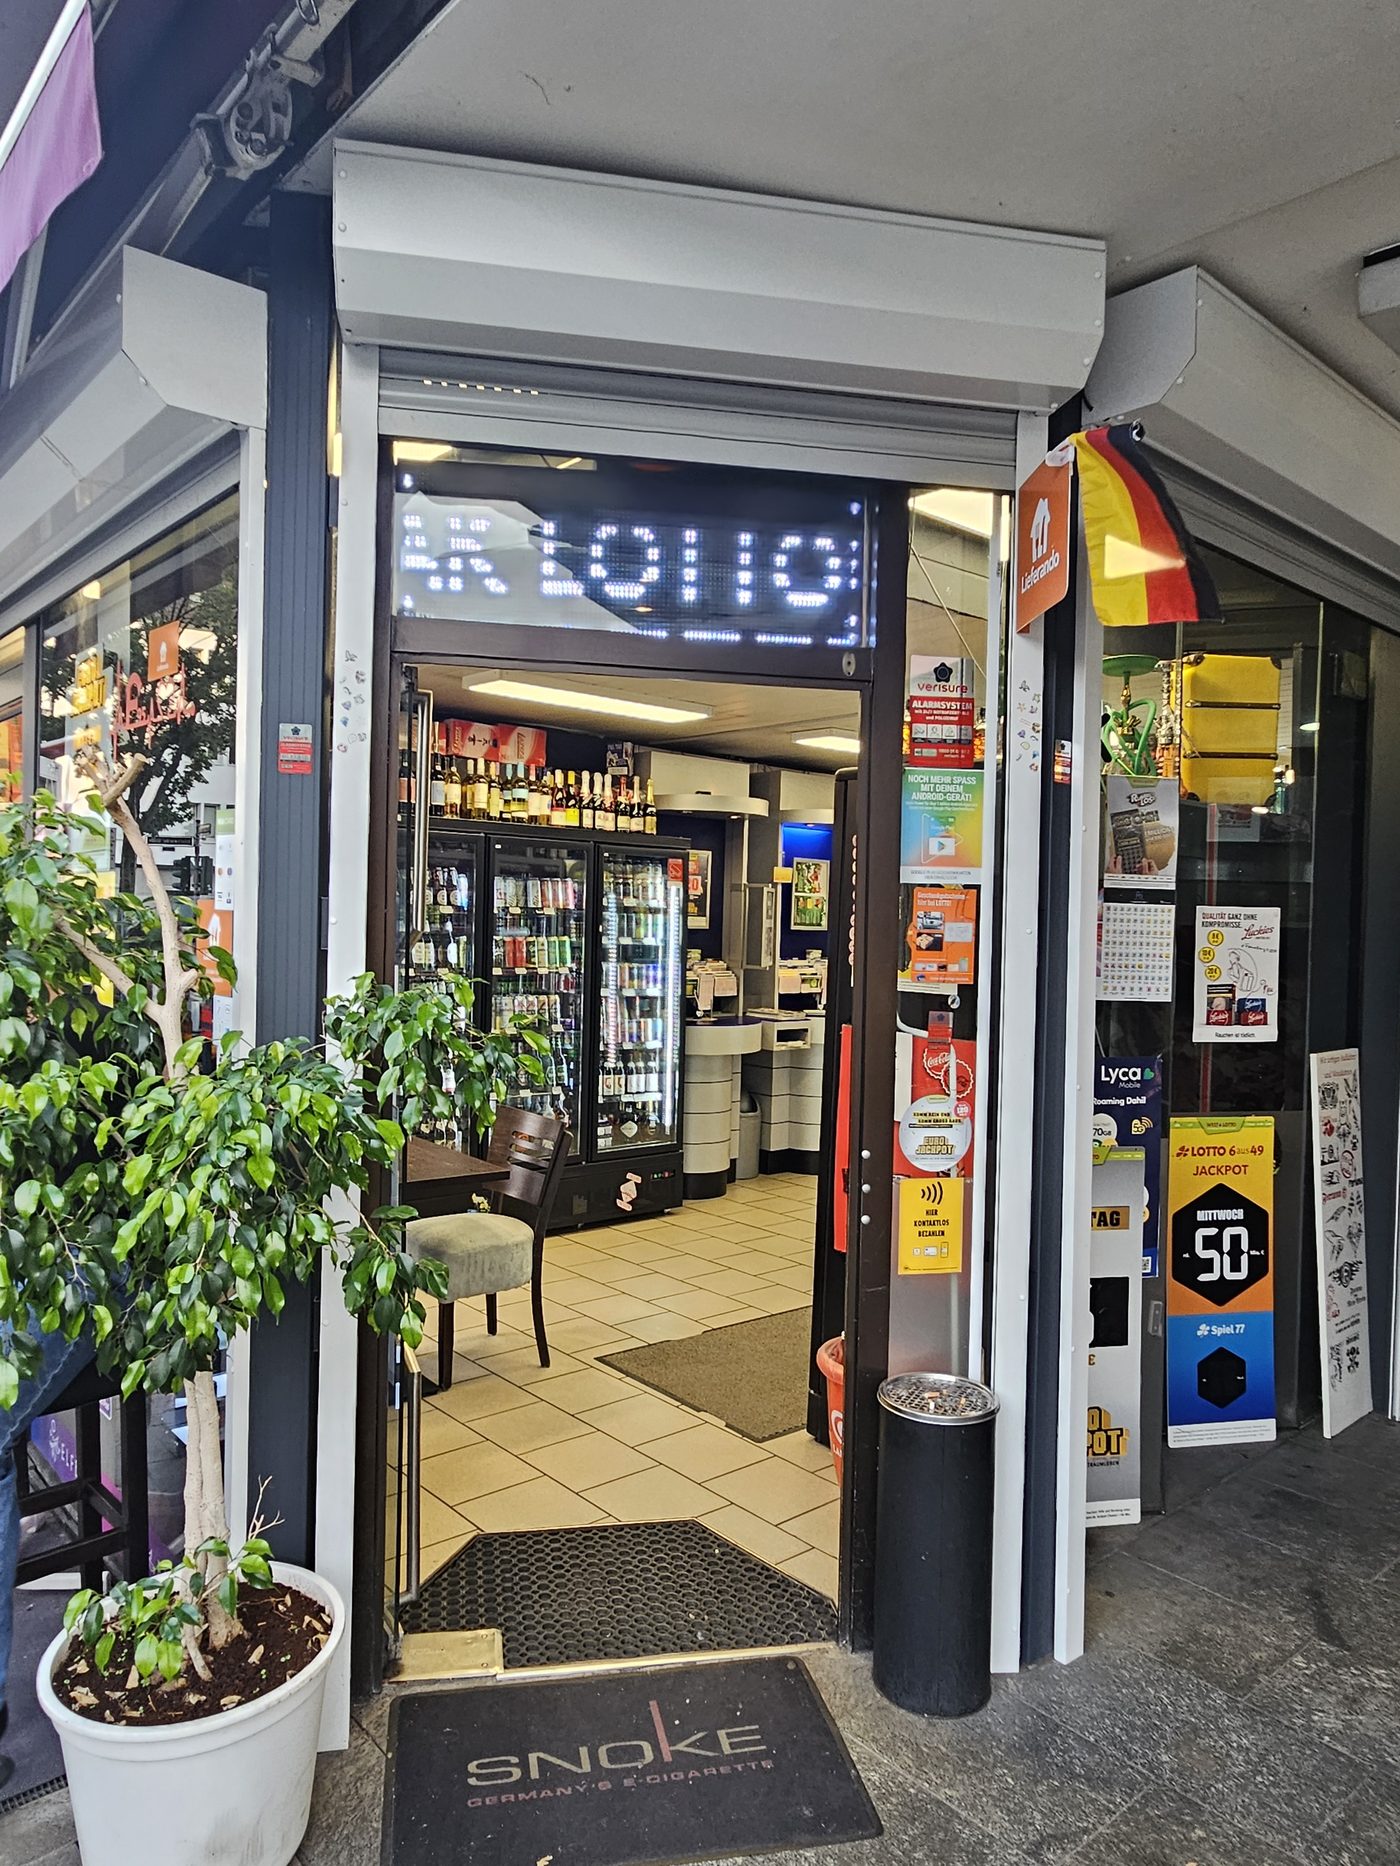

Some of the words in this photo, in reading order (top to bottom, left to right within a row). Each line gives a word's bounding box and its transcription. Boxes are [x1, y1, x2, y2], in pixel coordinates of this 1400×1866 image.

[1021, 549, 1060, 593] Lieferando
[917, 683, 968, 694] verisure
[912, 700, 973, 710] ALARMSYSTEM
[908, 774, 929, 783] NOCH
[930, 775, 952, 784] MEHR
[953, 776, 976, 785] SPASS
[920, 783, 935, 791] MIT
[935, 784, 963, 793] DEINEM
[911, 792, 972, 802] ANDROID-GERÄT!
[1201, 912, 1226, 921] QUALITÄT
[1227, 913, 1242, 921] GANZ
[1243, 914, 1258, 922] OHNE
[1201, 921, 1243, 930] KOMPROMISSE.
[1241, 924, 1275, 941] Luckies
[1100, 1064, 1142, 1085] Lyca
[1118, 1082, 1142, 1090] Mobile
[1126, 1096, 1147, 1105] Dahil
[922, 1136, 946, 1146] EURO
[915, 1144, 955, 1155] JACKPOT
[1191, 1146, 1226, 1157] LOTTO
[1193, 1165, 1249, 1176] JACKPOT
[926, 1209, 939, 1217] HIER
[1197, 1209, 1244, 1221] MITTWOCH
[913, 1219, 950, 1227] KONTAKTLOS
[918, 1230, 945, 1238] BEZAHLEN
[1194, 1226, 1249, 1281] 50
[1210, 1325, 1235, 1337] Spiel
[1235, 1324, 1246, 1334] 77
[467, 1699, 767, 1787] SNOKE
